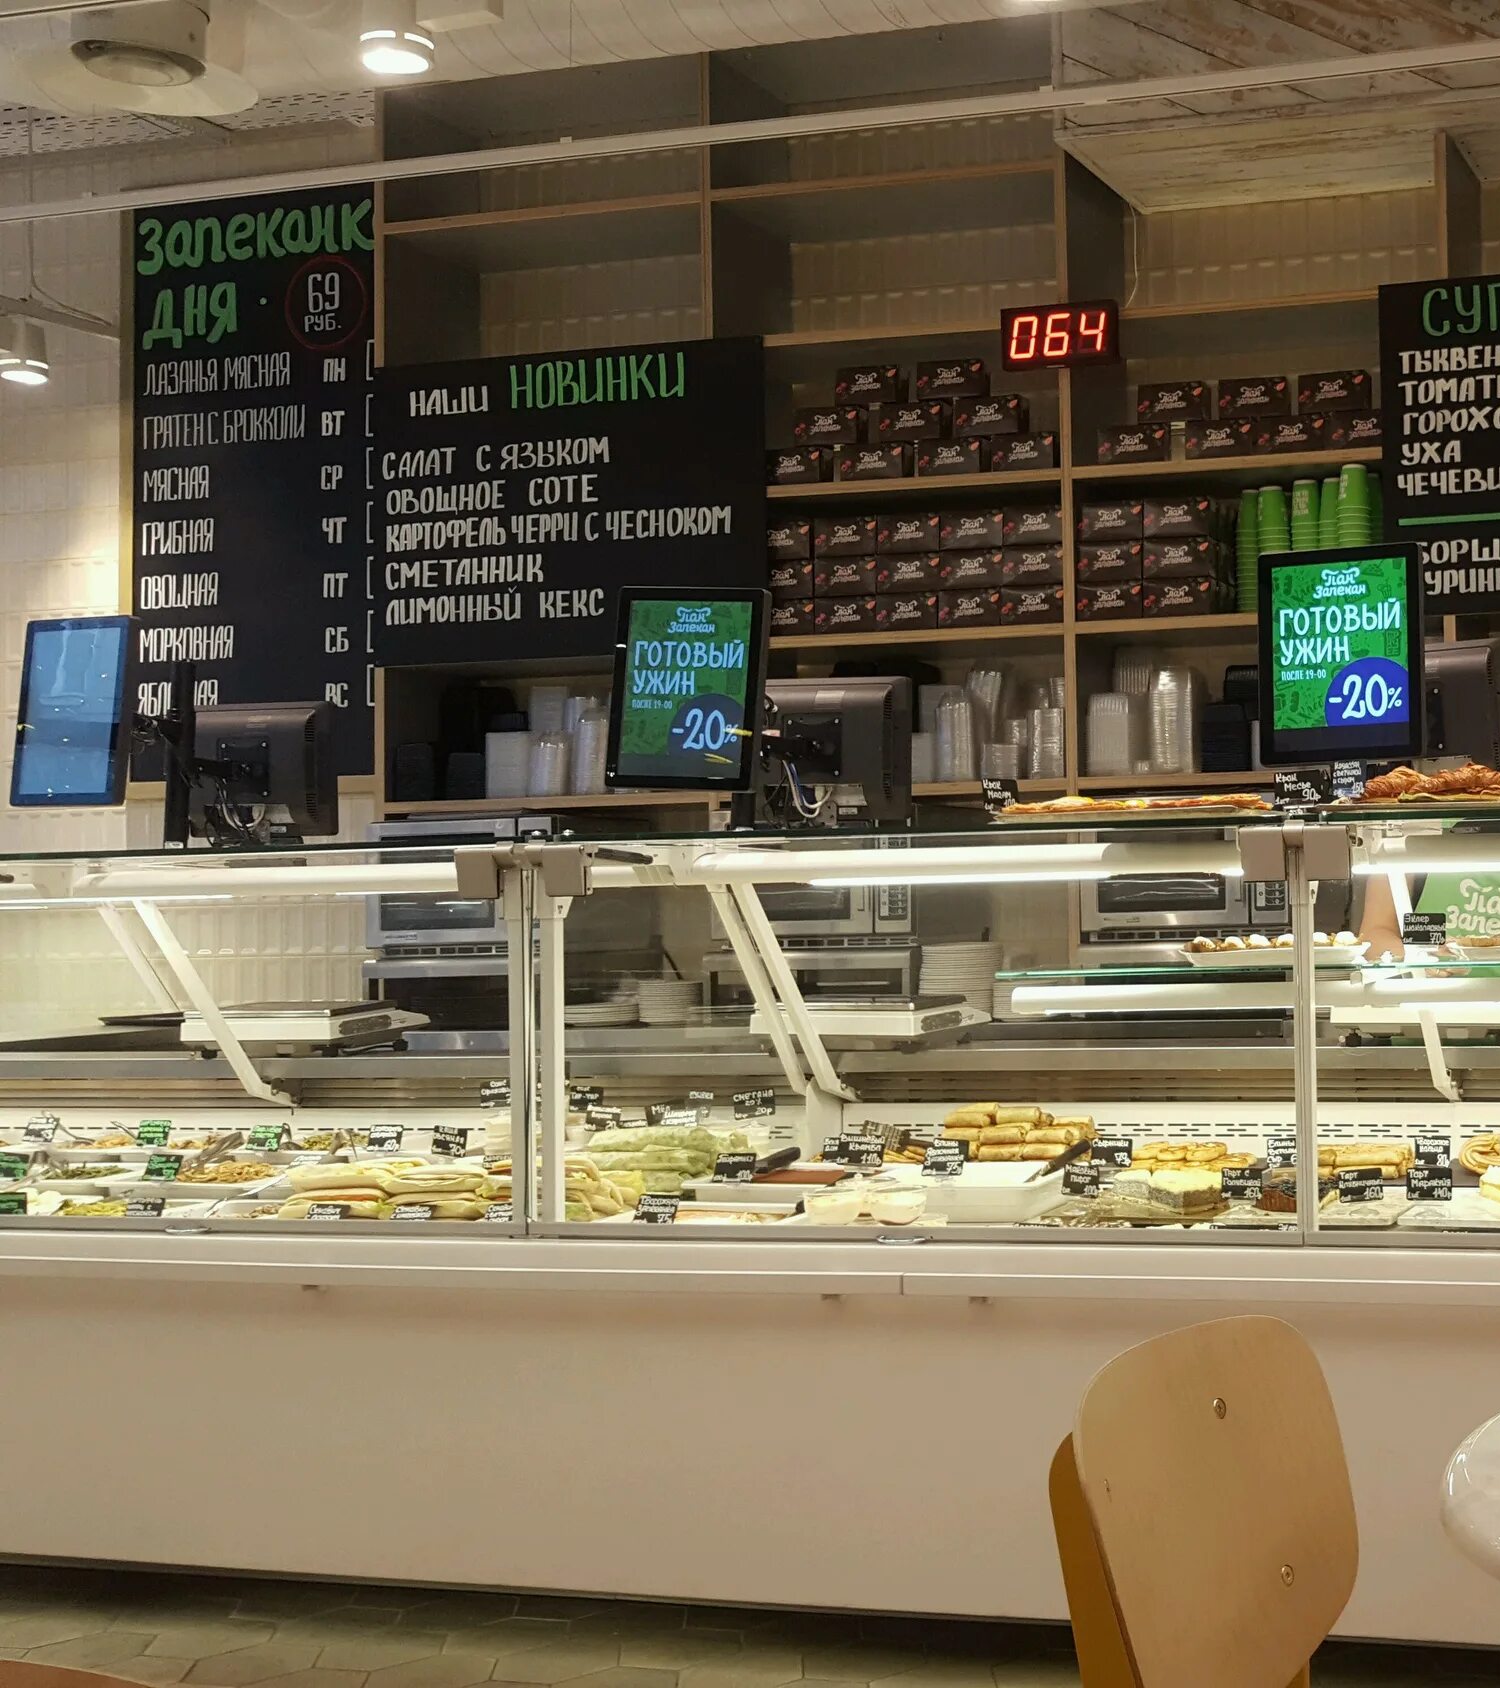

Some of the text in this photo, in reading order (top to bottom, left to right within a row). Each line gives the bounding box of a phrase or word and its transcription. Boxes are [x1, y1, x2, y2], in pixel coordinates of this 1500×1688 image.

[137, 199, 374, 275] Запеканк
[308, 272, 339, 313] 69
[142, 282, 237, 350] ДНЯ
[1010, 311, 1106, 359] 064
[143, 351, 346, 396] ЛАЗАНЬЯ МЯСНАЯ ПН
[409, 352, 685, 417] НАШИ НОВИНКИ
[143, 404, 345, 449] ГРАТЕН С БРОККОЛИ ВТ
[382, 436, 610, 480] САЛАТ С ЯЗЫКОМ
[1401, 440, 1462, 467] УХА
[143, 465, 343, 502] МЯСНАЯ СР
[385, 474, 599, 516] ОВОЩНОЕ СОТЕ
[142, 517, 347, 556] ГРИБНАЯ ЧТ
[385, 505, 732, 553] КАРТОФЕЛЬ ЧЕРРИ С ЧЕСНОКОМ
[141, 572, 348, 609] ОВОЩНАЯ ПТ
[385, 553, 544, 590] СМЕТАННИК
[1313, 584, 1366, 600] Запекан
[385, 585, 605, 626] ЛИМОННЫЙ КЕКС
[1279, 597, 1402, 637] ГОТОВЫЙ
[139, 625, 349, 663] МОРКОВНАЯ СБ
[634, 639, 745, 669] ГОТОВЫЙ
[1280, 635, 1350, 666] УЖИН
[632, 669, 695, 696] УЖИН
[1281, 668, 1327, 681] ПОСЛЕ 19-00
[1328, 673, 1403, 720] -20%
[671, 708, 739, 750] -20%
